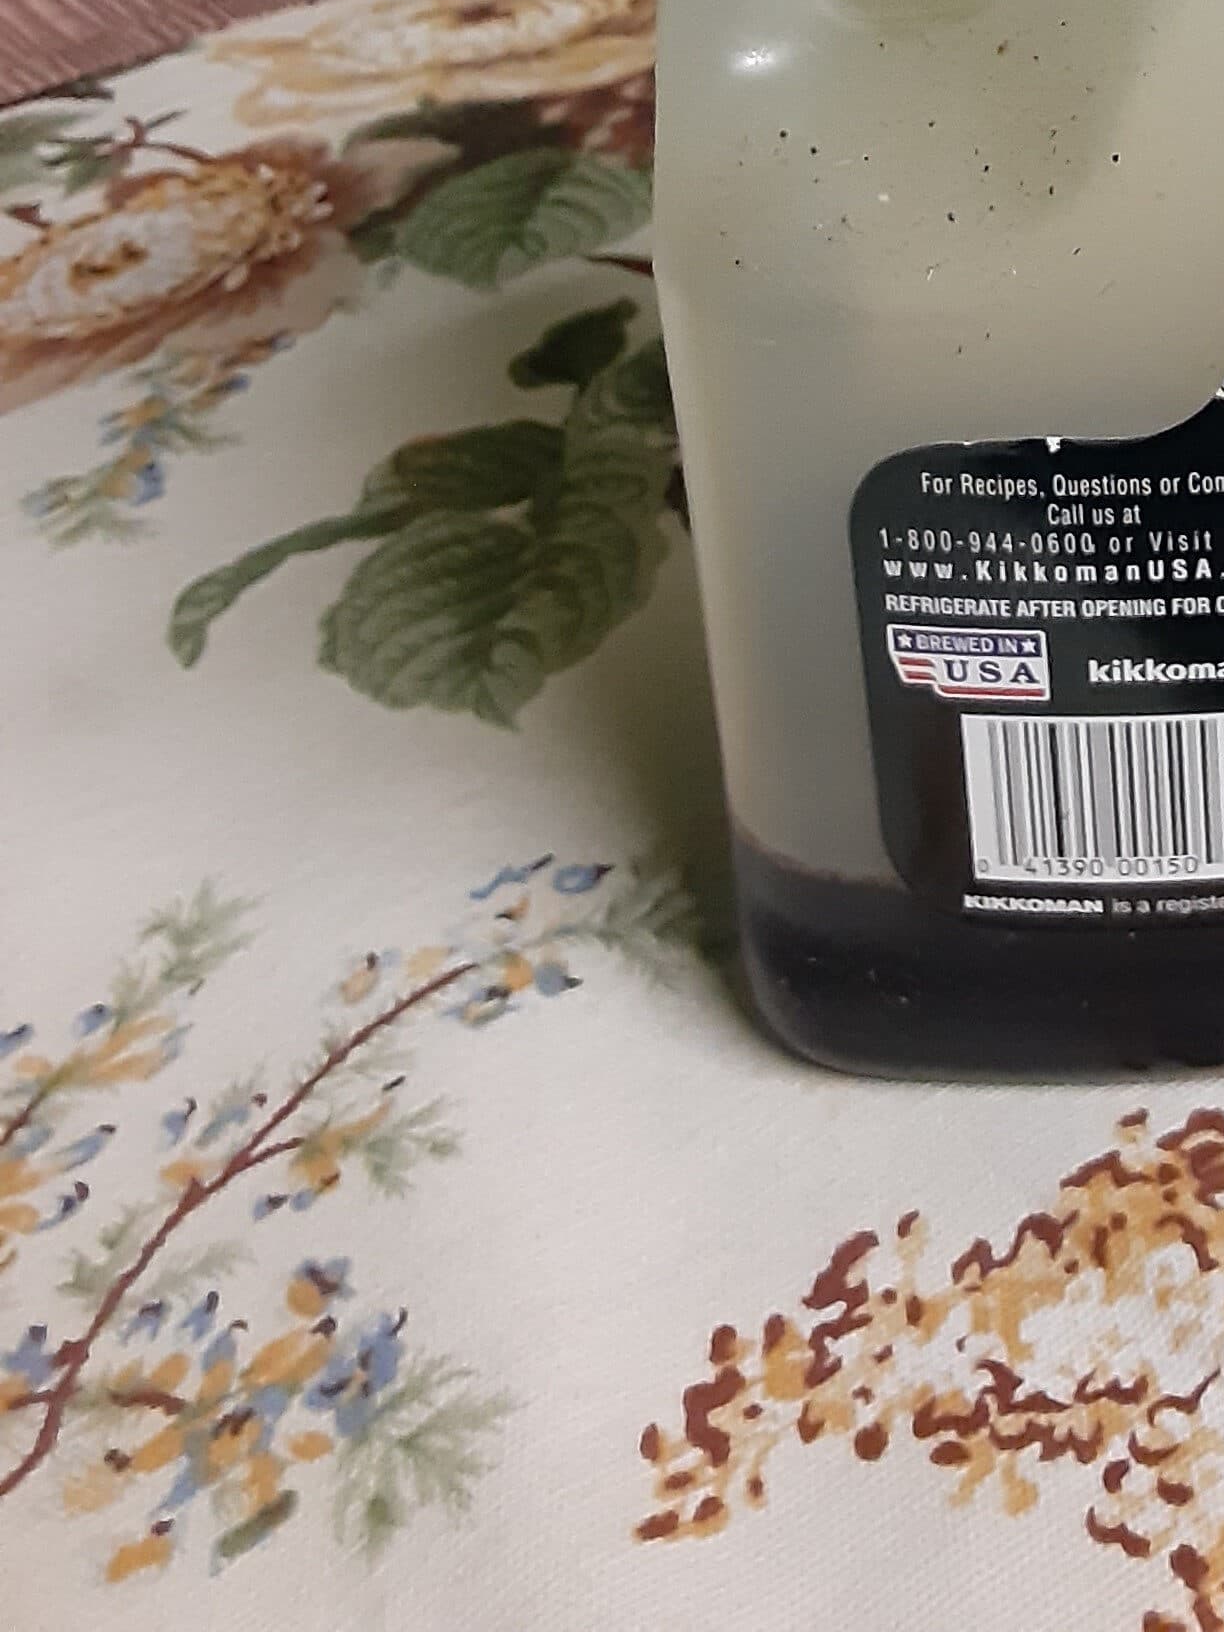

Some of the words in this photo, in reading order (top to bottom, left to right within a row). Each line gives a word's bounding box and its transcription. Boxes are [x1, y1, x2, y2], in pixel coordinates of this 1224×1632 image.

[921, 471, 953, 493] For
[959, 473, 1045, 501] Recipes,
[1052, 474, 1152, 497] Questions
[1159, 476, 1181, 495] or
[1047, 503, 1085, 525] Call
[1091, 507, 1115, 525] us
[1122, 504, 1142, 525] at
[1108, 535, 1134, 554] or
[1149, 530, 1213, 552] Visit
[885, 594, 1011, 617] REFRIGERATE
[1017, 599, 1076, 618] AFTER
[1081, 597, 1167, 618] OPENING
[1172, 596, 1212, 616] FOR
[915, 633, 994, 653] BREWED
[996, 638, 1018, 654] IN
[1118, 856, 1199, 876] 00150
[963, 894, 1105, 915] KIKKOMAN
[1111, 897, 1132, 914] is
[1137, 900, 1151, 914] a
